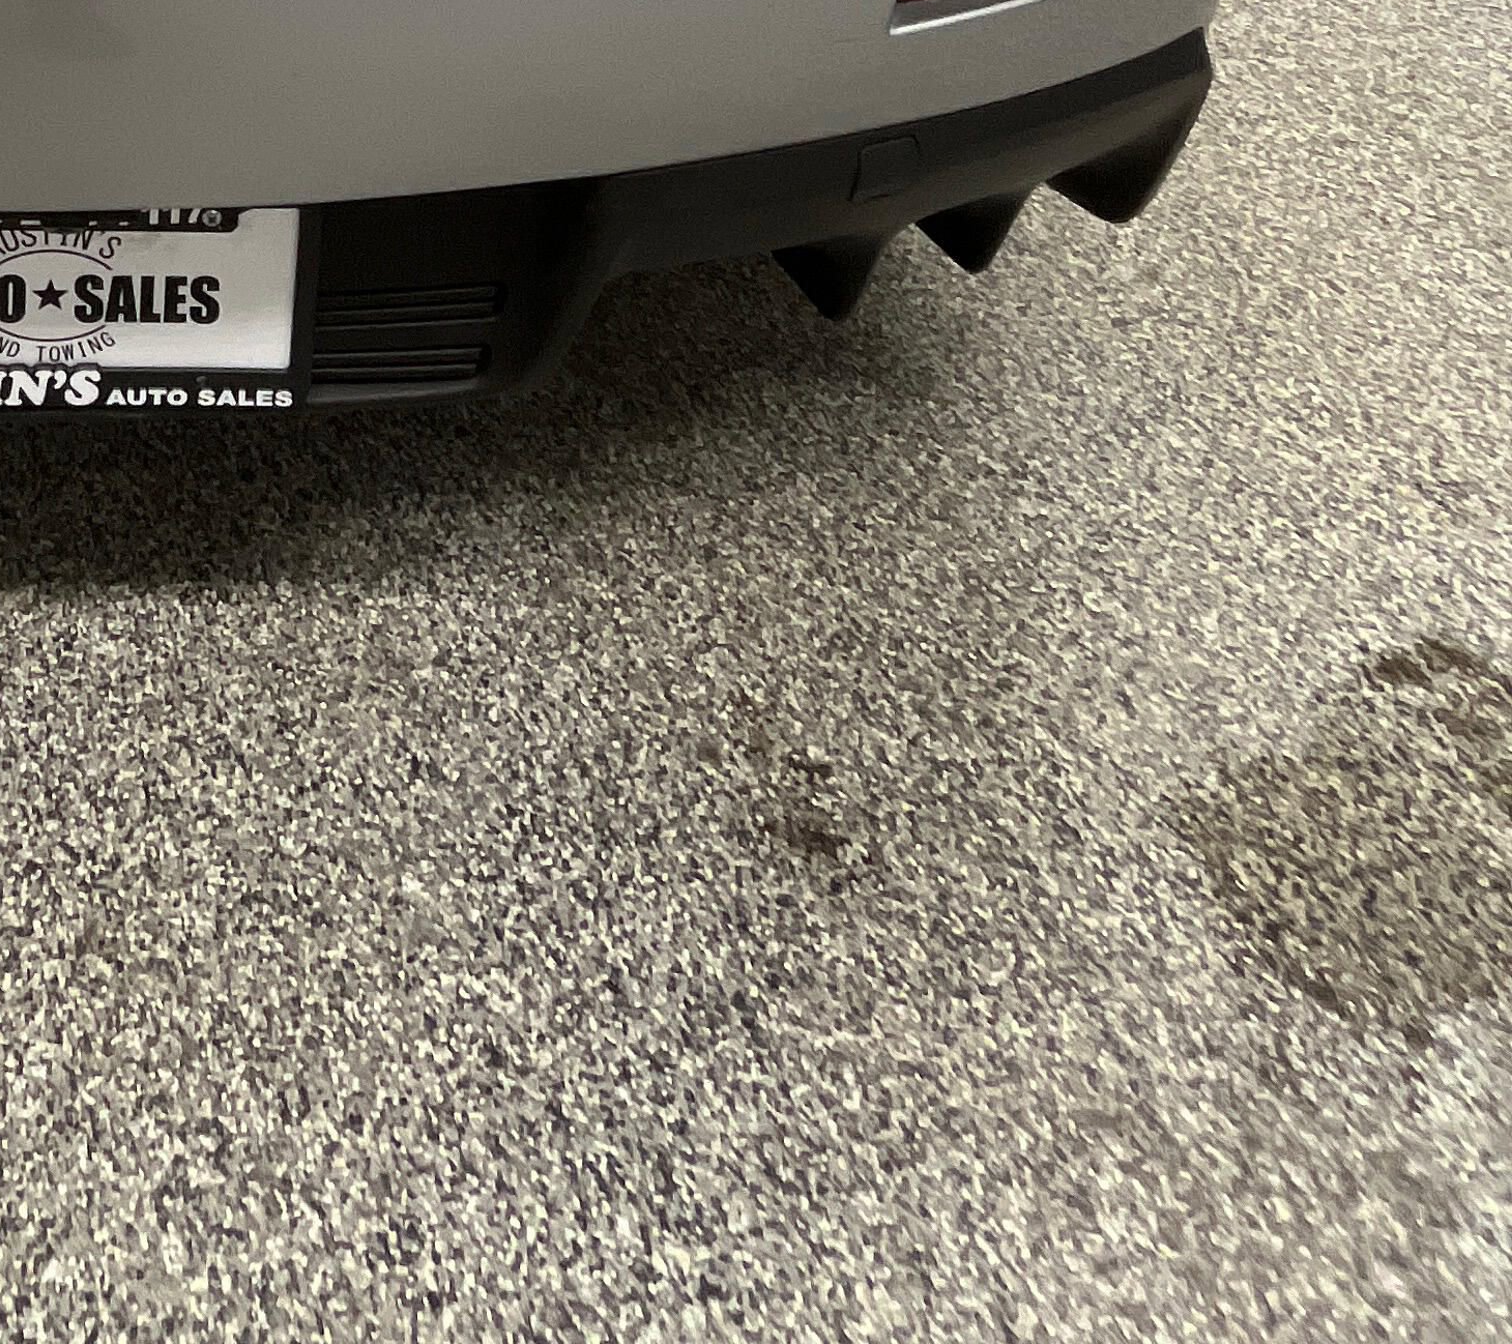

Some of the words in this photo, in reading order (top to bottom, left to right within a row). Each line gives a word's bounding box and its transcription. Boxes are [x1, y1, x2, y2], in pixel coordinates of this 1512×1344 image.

[73, 274, 221, 324] SALES
[36, 331, 116, 363] TOWING
[105, 387, 189, 407] AUTO
[197, 388, 294, 408] SALES
